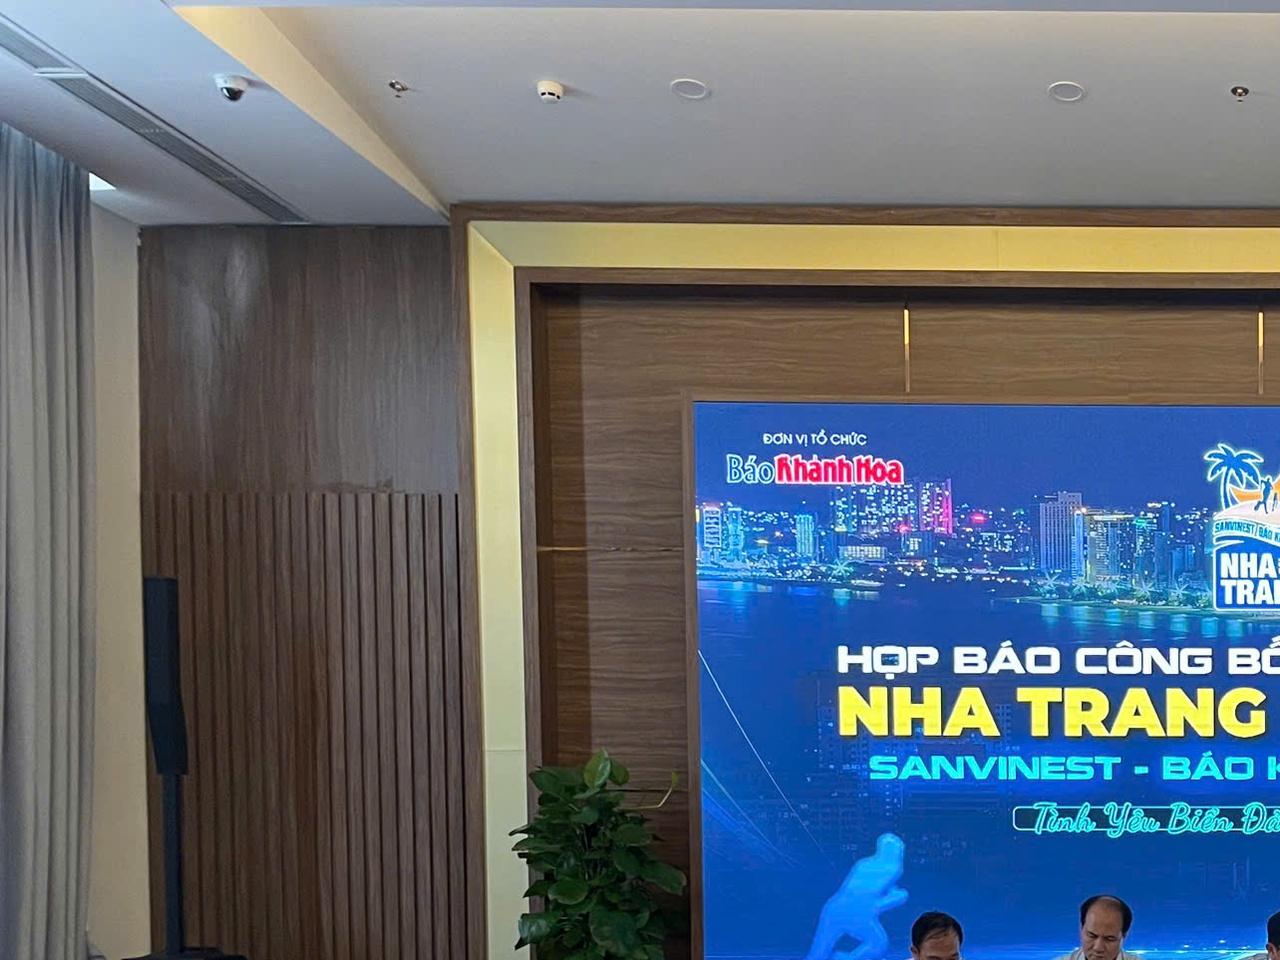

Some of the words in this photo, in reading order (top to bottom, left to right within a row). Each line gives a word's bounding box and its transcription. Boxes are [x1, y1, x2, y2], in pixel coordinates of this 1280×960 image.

[763, 432, 793, 445] ĐƠN
[795, 433, 808, 447] VỊ
[810, 429, 828, 446] TỔ
[830, 431, 867, 446] CHỨC
[1220, 552, 1278, 579] NHA
[837, 645, 939, 680] HỌP
[953, 640, 1061, 675] BÁO
[1075, 641, 1213, 675] CÔNG
[837, 686, 1001, 737] NHA
[1017, 686, 1267, 738] TRANG
[869, 755, 1121, 781] SANVINEST
[1162, 750, 1254, 781] BÁO
[1033, 802, 1096, 834] Tình
[1104, 802, 1160, 838] Yêu
[1168, 802, 1234, 834] Biển
